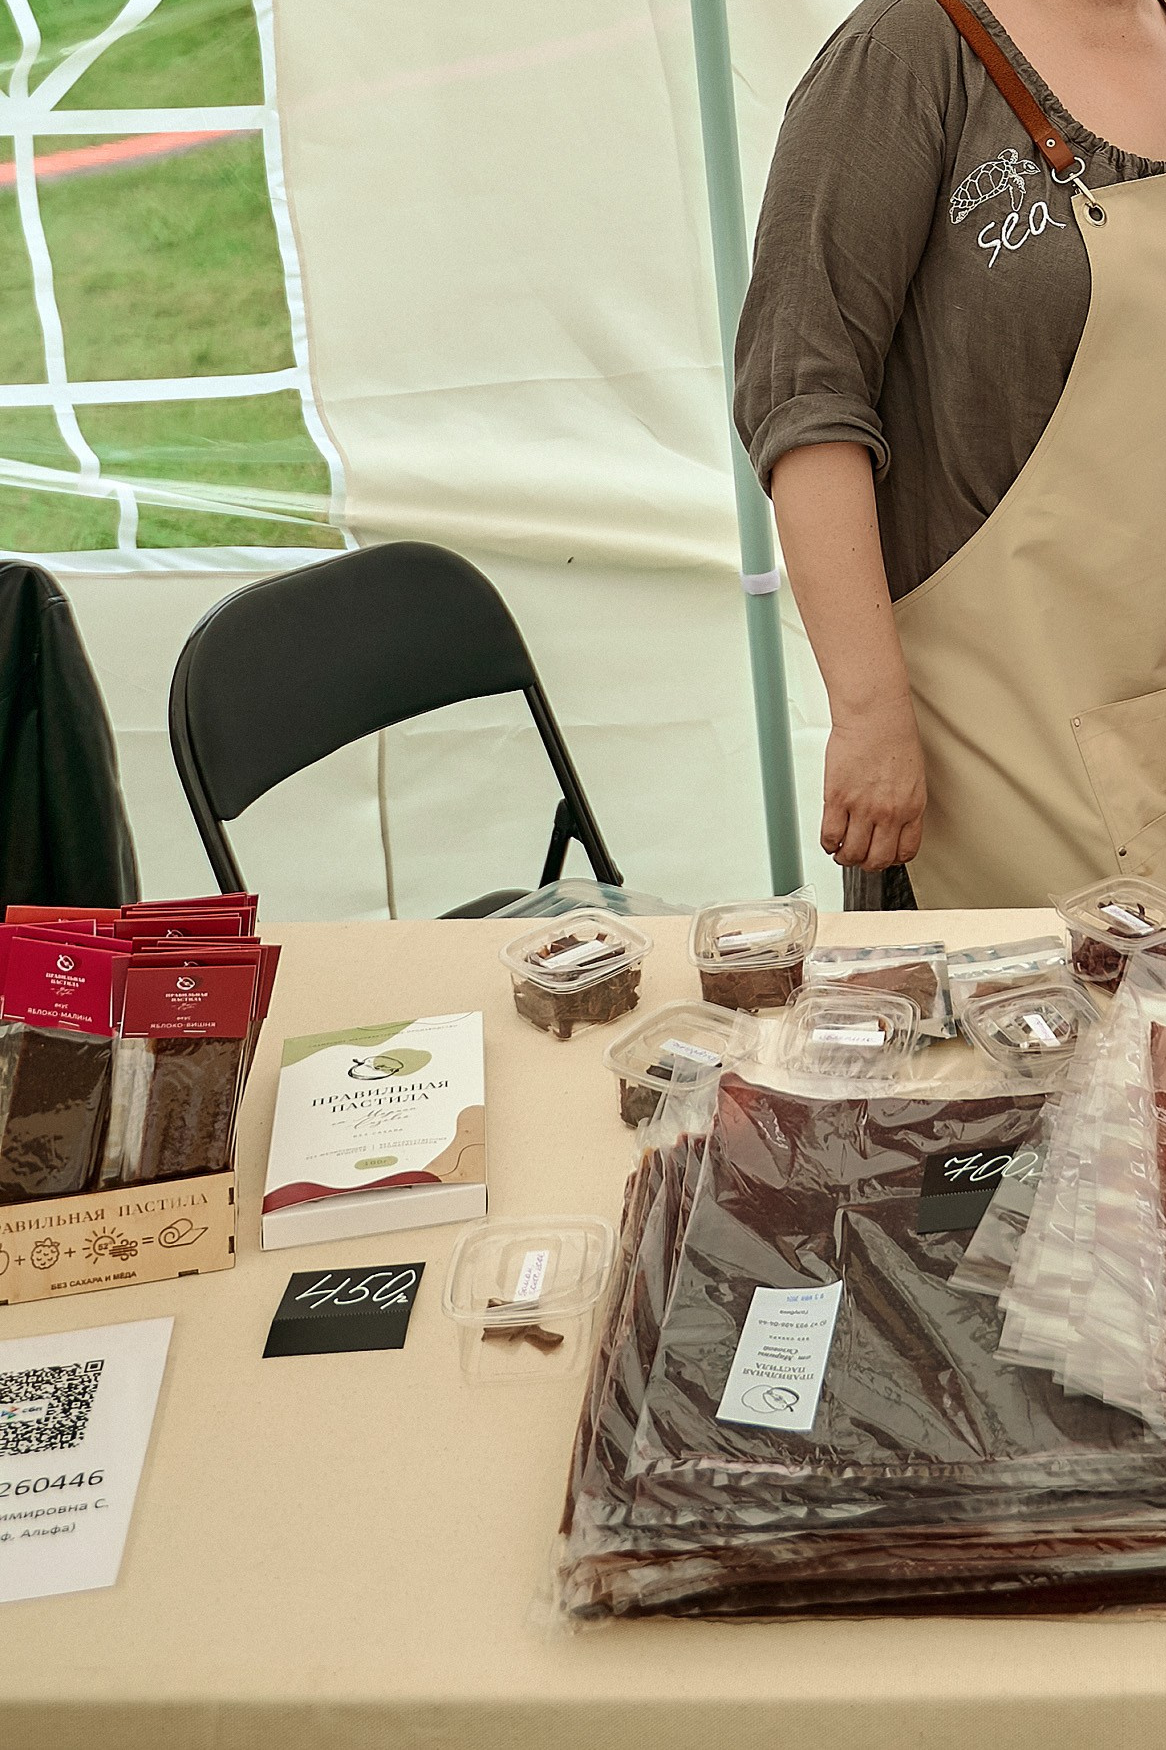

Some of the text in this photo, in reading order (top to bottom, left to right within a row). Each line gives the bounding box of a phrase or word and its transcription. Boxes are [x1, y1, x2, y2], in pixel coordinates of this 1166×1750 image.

[977, 201, 1067, 268] sea
[311, 1080, 449, 1107] ПРАВИЛЬНАЯ
[331, 1092, 430, 1113] ПАСТИЛА
[0, 1193, 208, 1235] АВИЛЬНАЯ ПАСТИЛА
[51, 1282, 68, 1291] БЕЗ
[69, 1276, 103, 1288] САХАРА
[105, 1274, 112, 1282] И
[757, 1351, 794, 1362] Марины
[742, 1368, 815, 1381] ПРАВИЛЬНАЯ
[755, 1362, 806, 1373] ПАСТИЛА
[94, 1498, 109, 1509] С.
[20, 1522, 76, 1539] Альфа)
